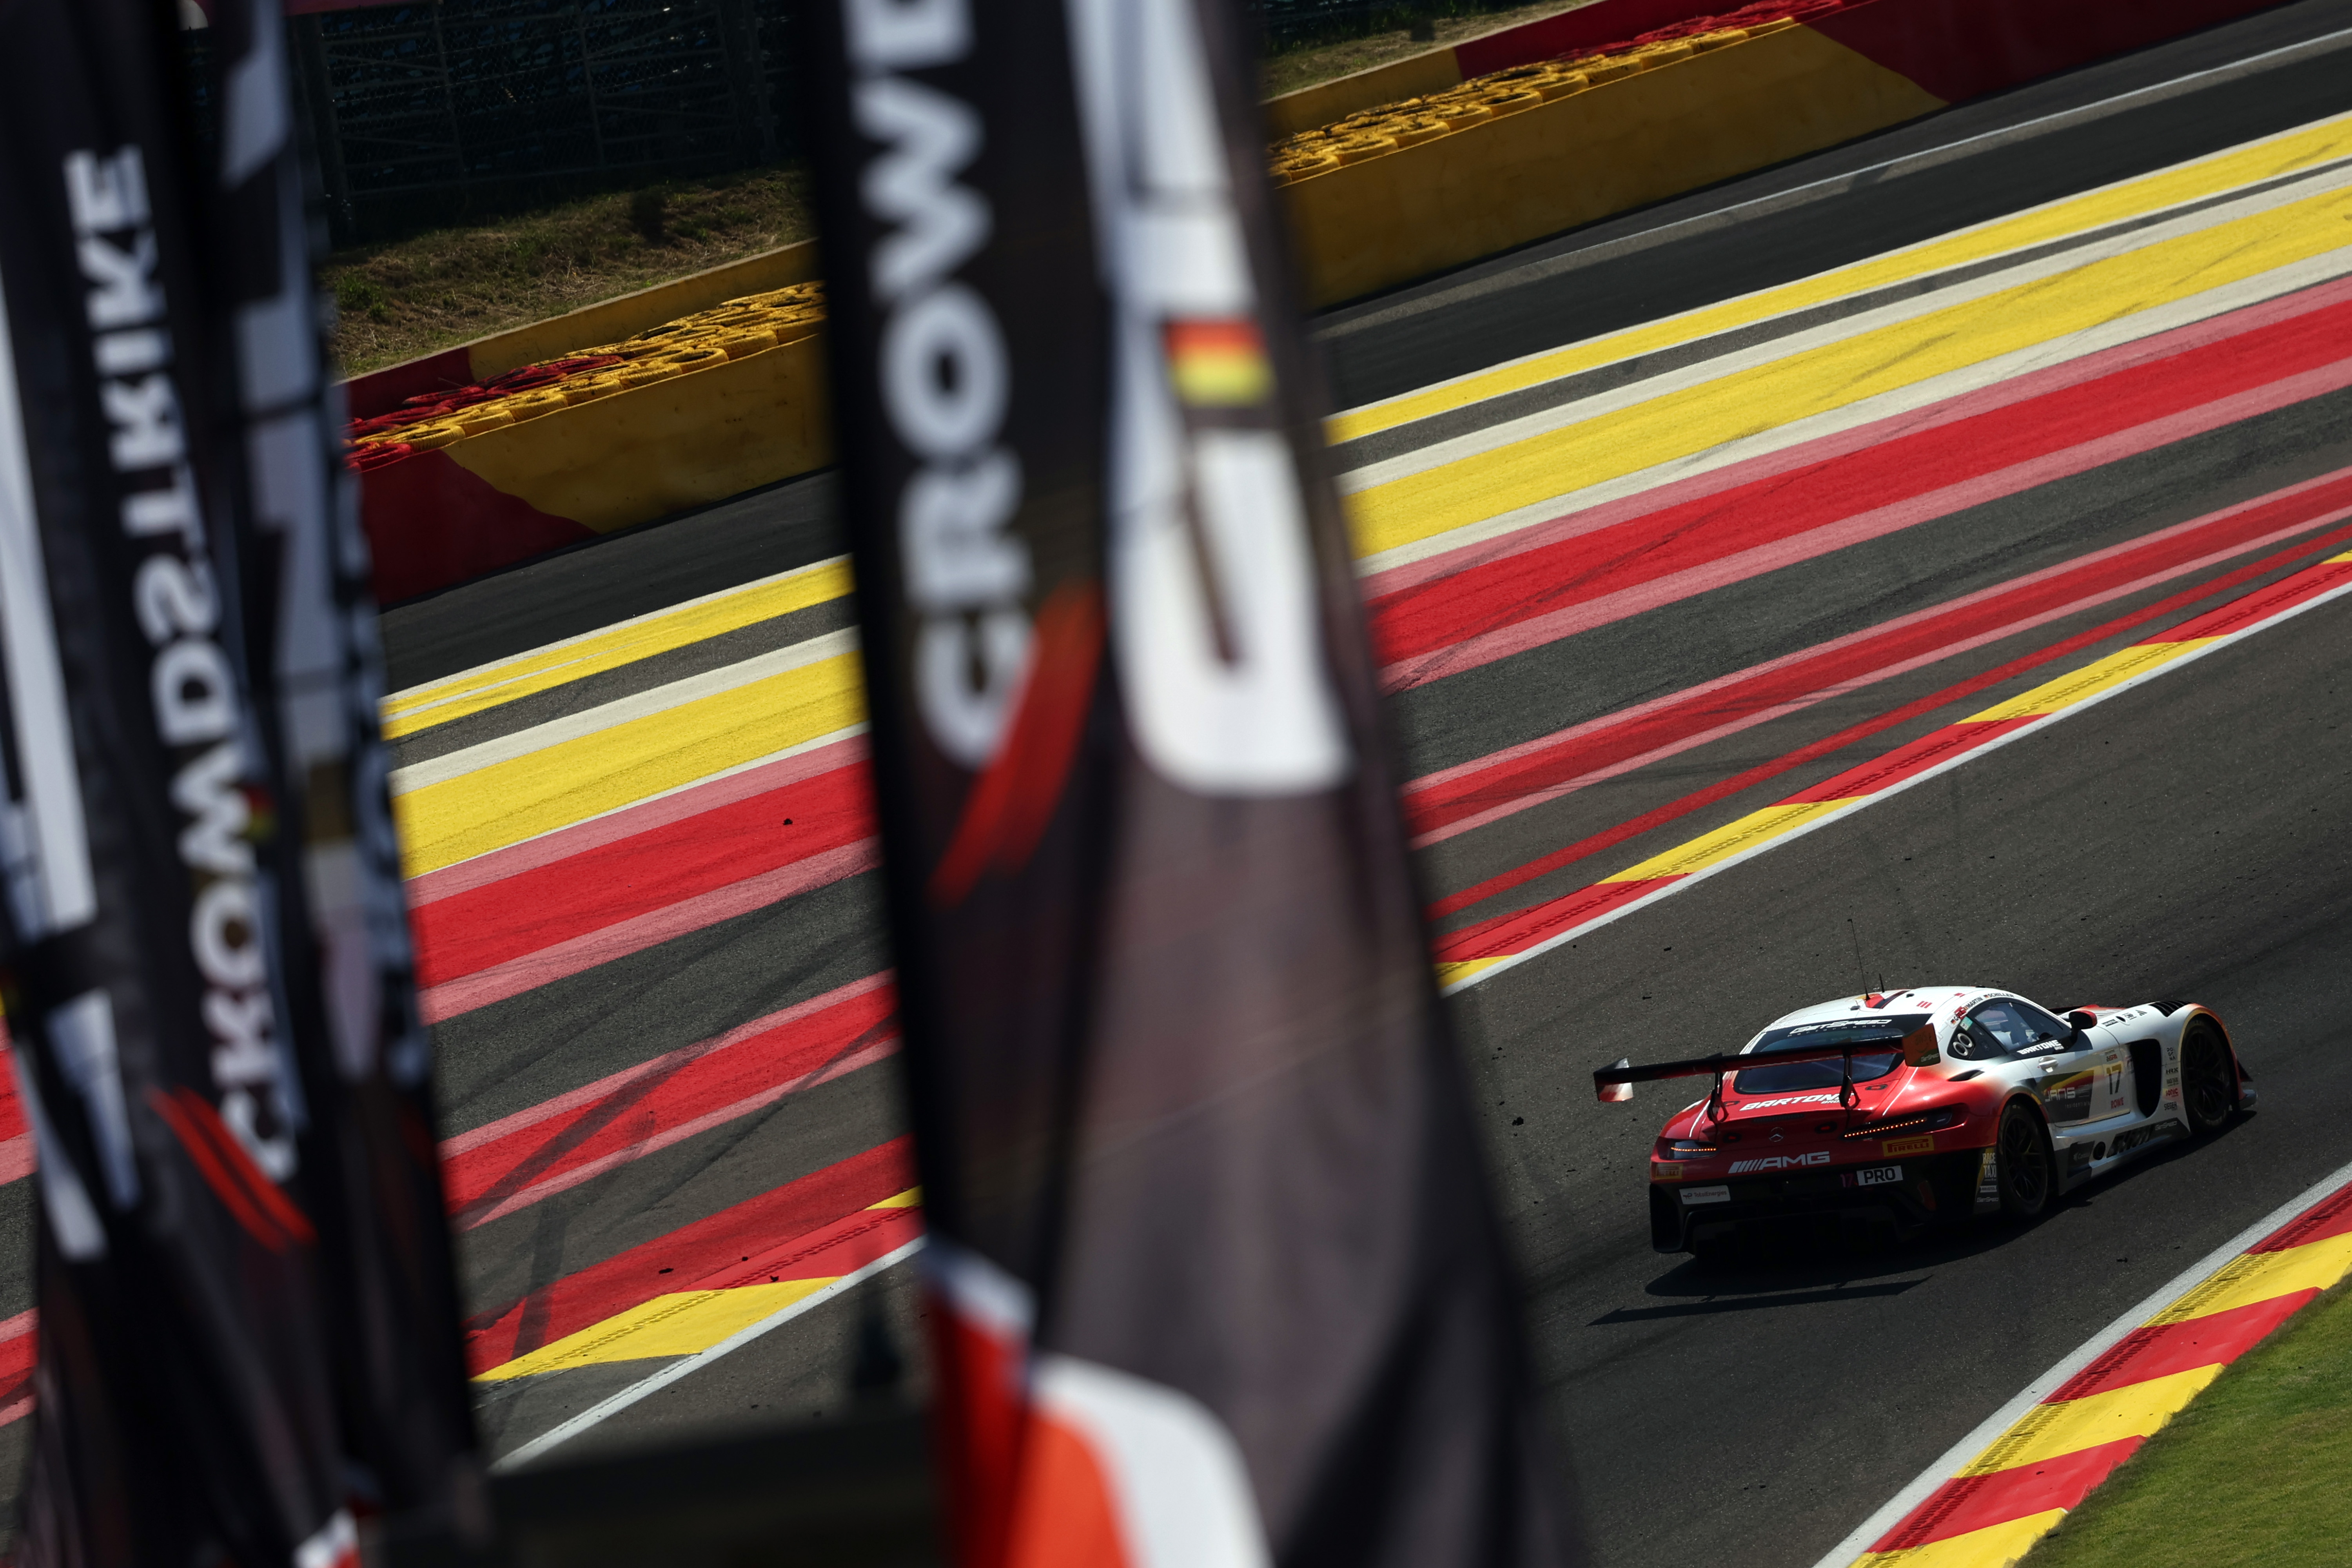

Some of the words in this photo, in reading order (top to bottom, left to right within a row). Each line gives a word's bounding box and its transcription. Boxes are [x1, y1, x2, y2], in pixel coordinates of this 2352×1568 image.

[1966, 996, 1983, 1009] MARTIN
[2017, 1040, 2062, 1055] BARTONE
[2106, 1064, 2121, 1095] 17
[1739, 1093, 1840, 1111] BARTON
[2111, 1097, 2124, 1109] ROWE
[1887, 1138, 1929, 1153] PIRELLI
[1759, 1151, 1830, 1170] AMG
[1982, 1152, 1996, 1163] RACE
[1863, 1167, 1896, 1183] PRO
[1983, 1165, 1996, 1178] TAXI
